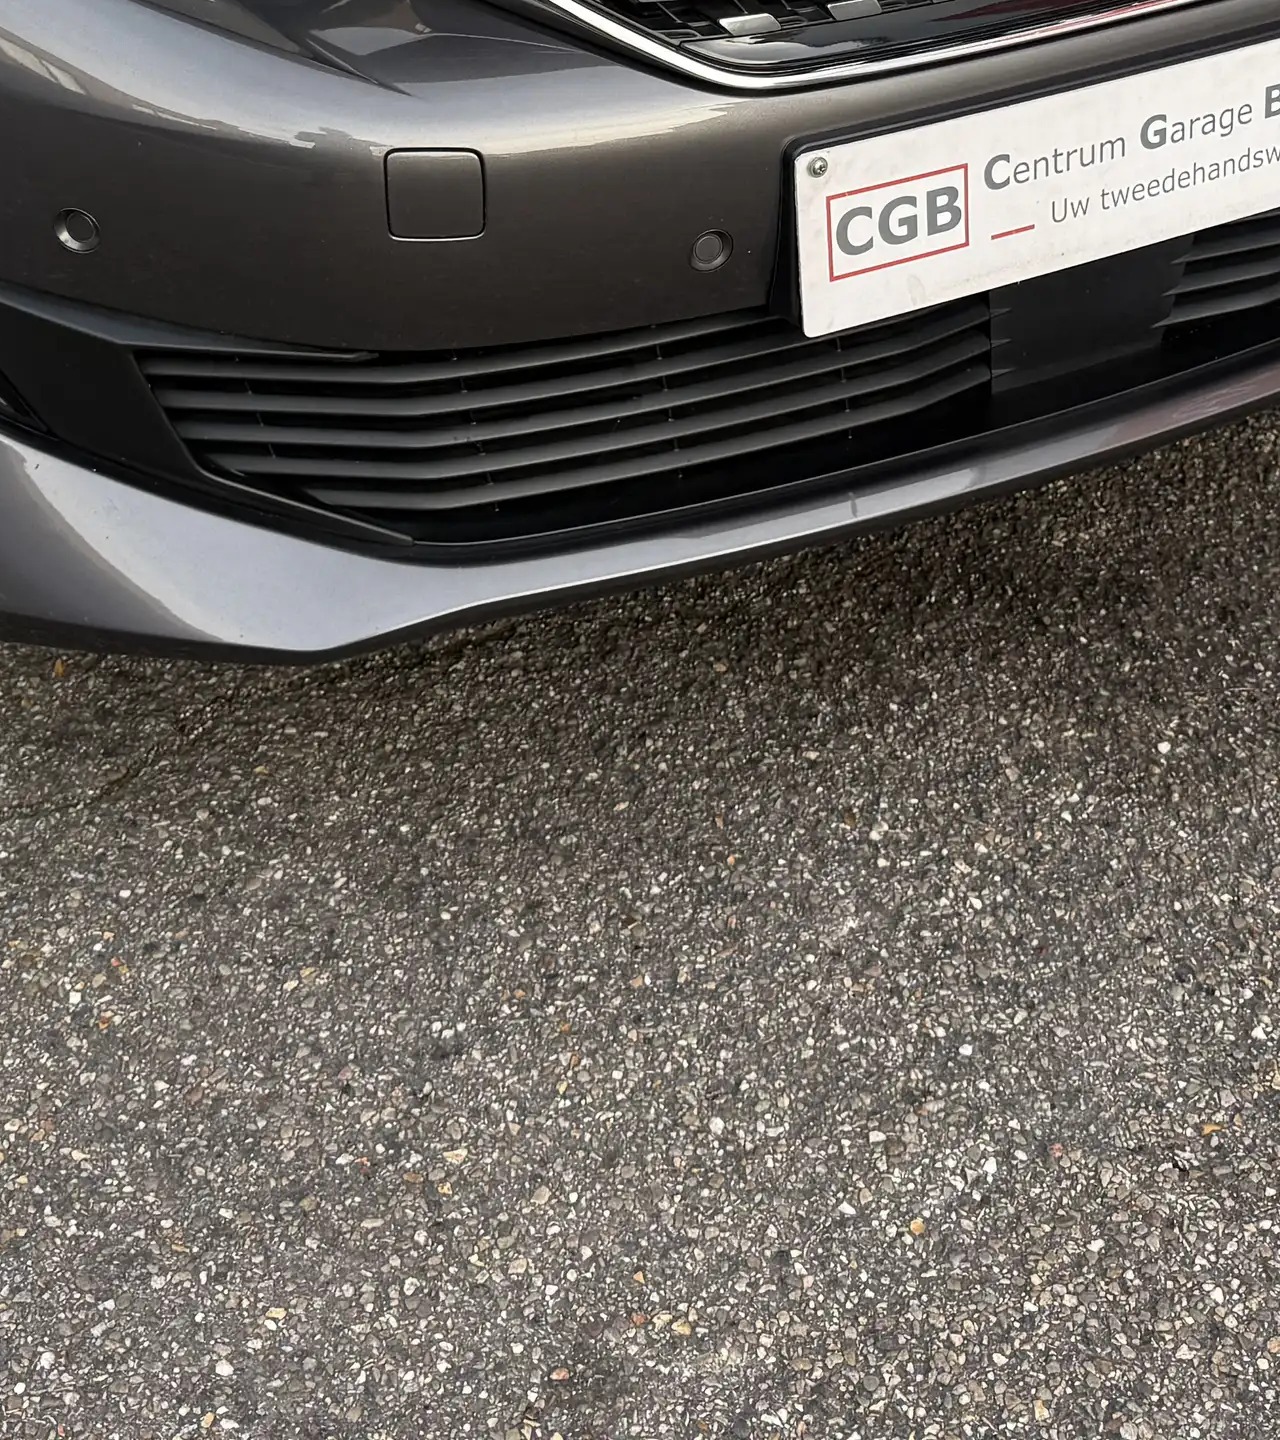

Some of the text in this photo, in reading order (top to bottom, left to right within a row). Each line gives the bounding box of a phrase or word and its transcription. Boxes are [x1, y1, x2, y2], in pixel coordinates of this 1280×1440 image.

[983, 136, 1126, 190] Centrum
[1140, 103, 1253, 150] Garage
[835, 185, 962, 256] CGB
[1051, 196, 1090, 224] Uw
